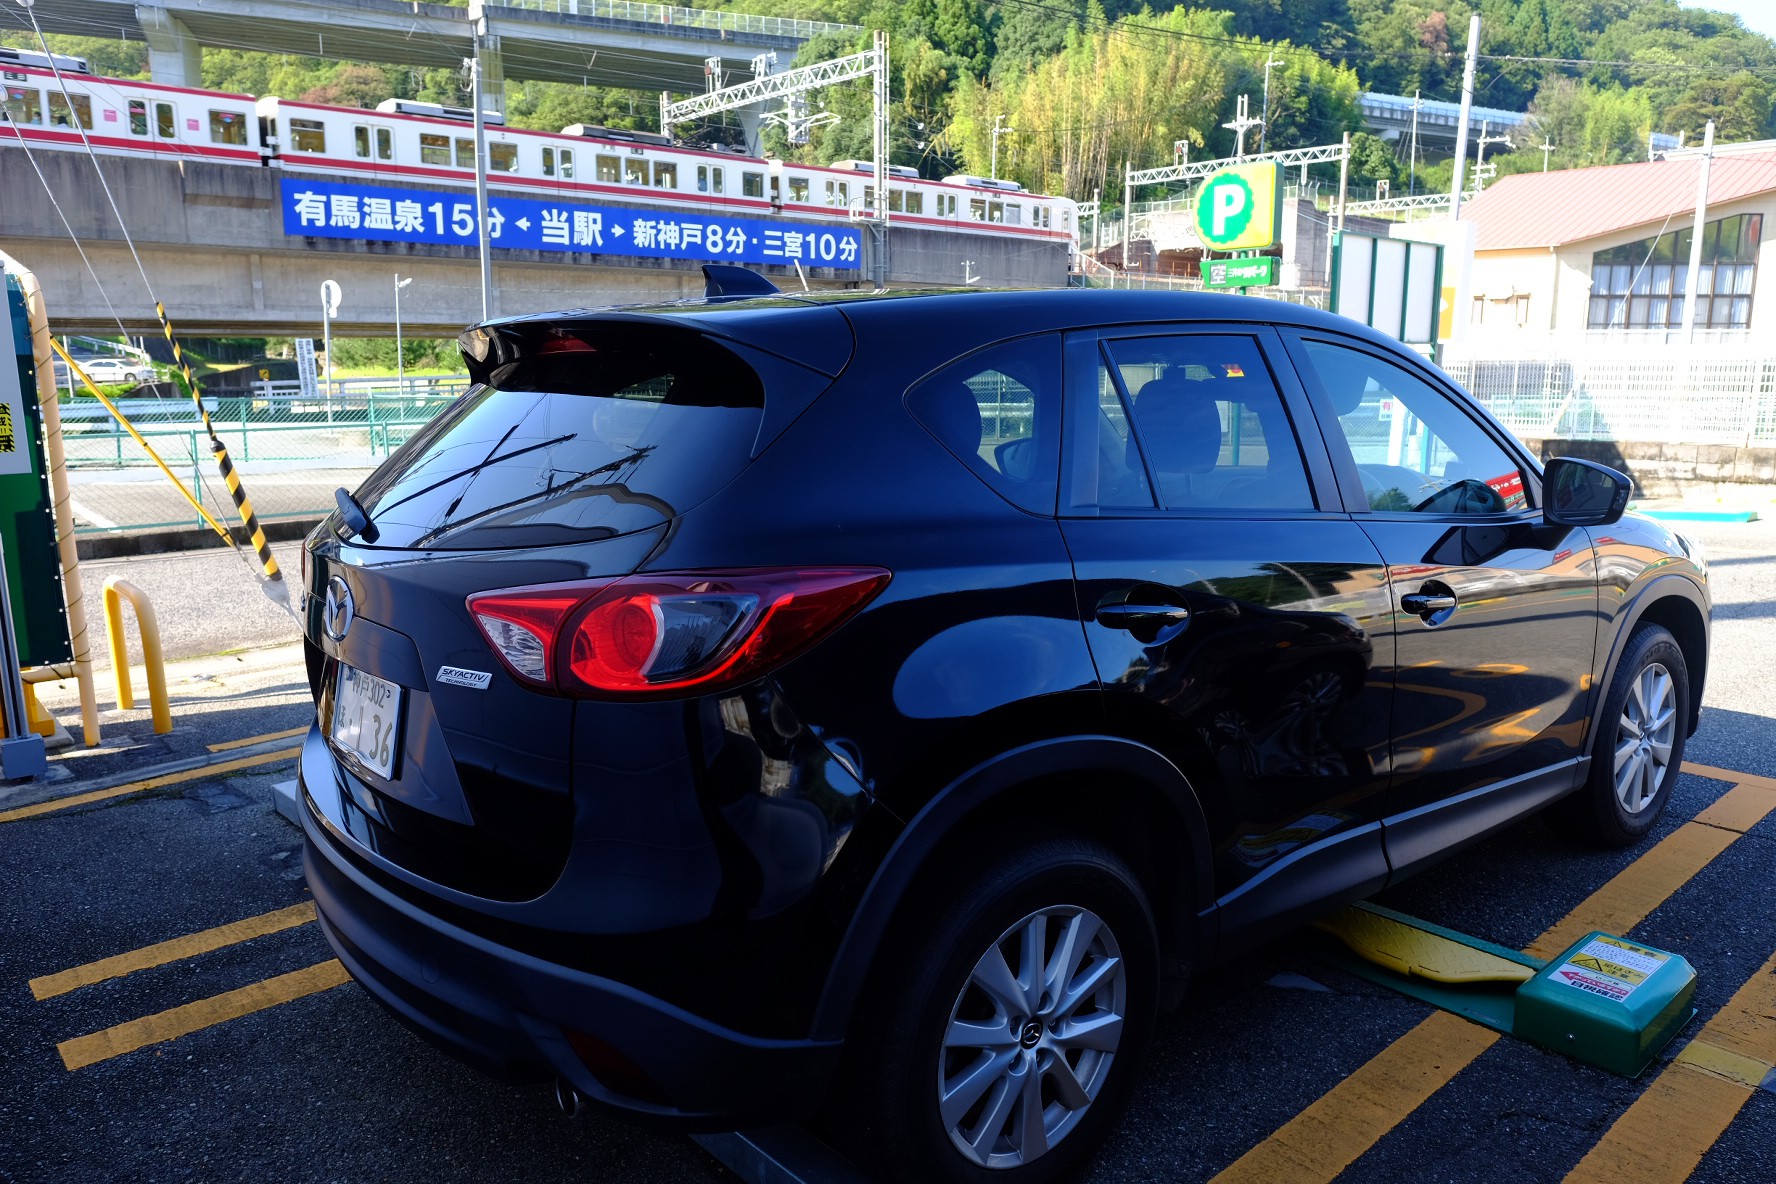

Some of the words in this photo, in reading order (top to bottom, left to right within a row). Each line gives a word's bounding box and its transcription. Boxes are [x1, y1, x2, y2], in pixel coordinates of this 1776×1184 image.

[541, 208, 603, 247] 当駅
[1213, 185, 1245, 236] P
[442, 668, 485, 681] SKYACTIV
